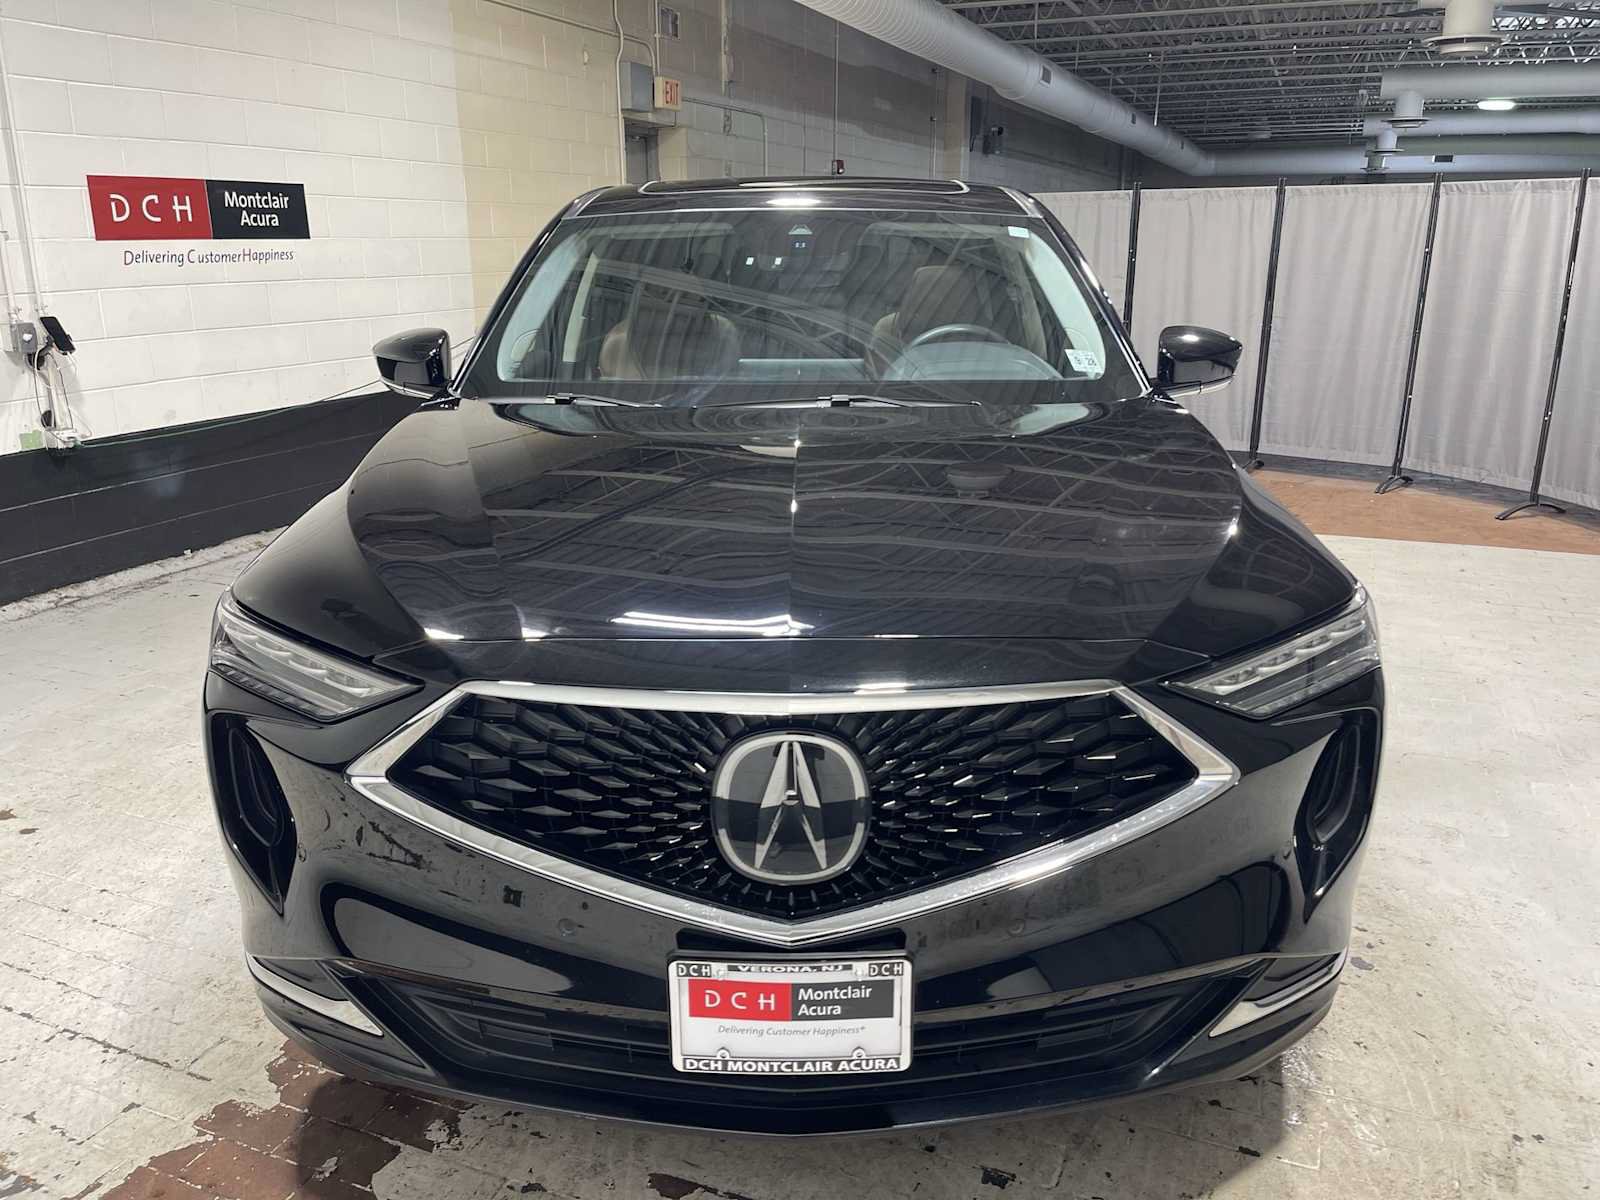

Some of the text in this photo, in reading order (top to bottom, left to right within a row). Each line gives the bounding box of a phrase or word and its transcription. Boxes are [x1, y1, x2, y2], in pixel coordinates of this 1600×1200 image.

[665, 80, 679, 105] EXIT
[224, 191, 289, 209] Montclair
[240, 210, 280, 227] Acura
[123, 249, 185, 268] Delivering
[242, 248, 295, 265] Happiness
[823, 964, 843, 972] NJ
[797, 985, 872, 1001] Montclair
[797, 1003, 842, 1016] Acura
[718, 1024, 766, 1037] Delivering
[766, 1025, 811, 1036] Customer
[685, 1058, 898, 1073] DCH MONTCLAIR ACURA
